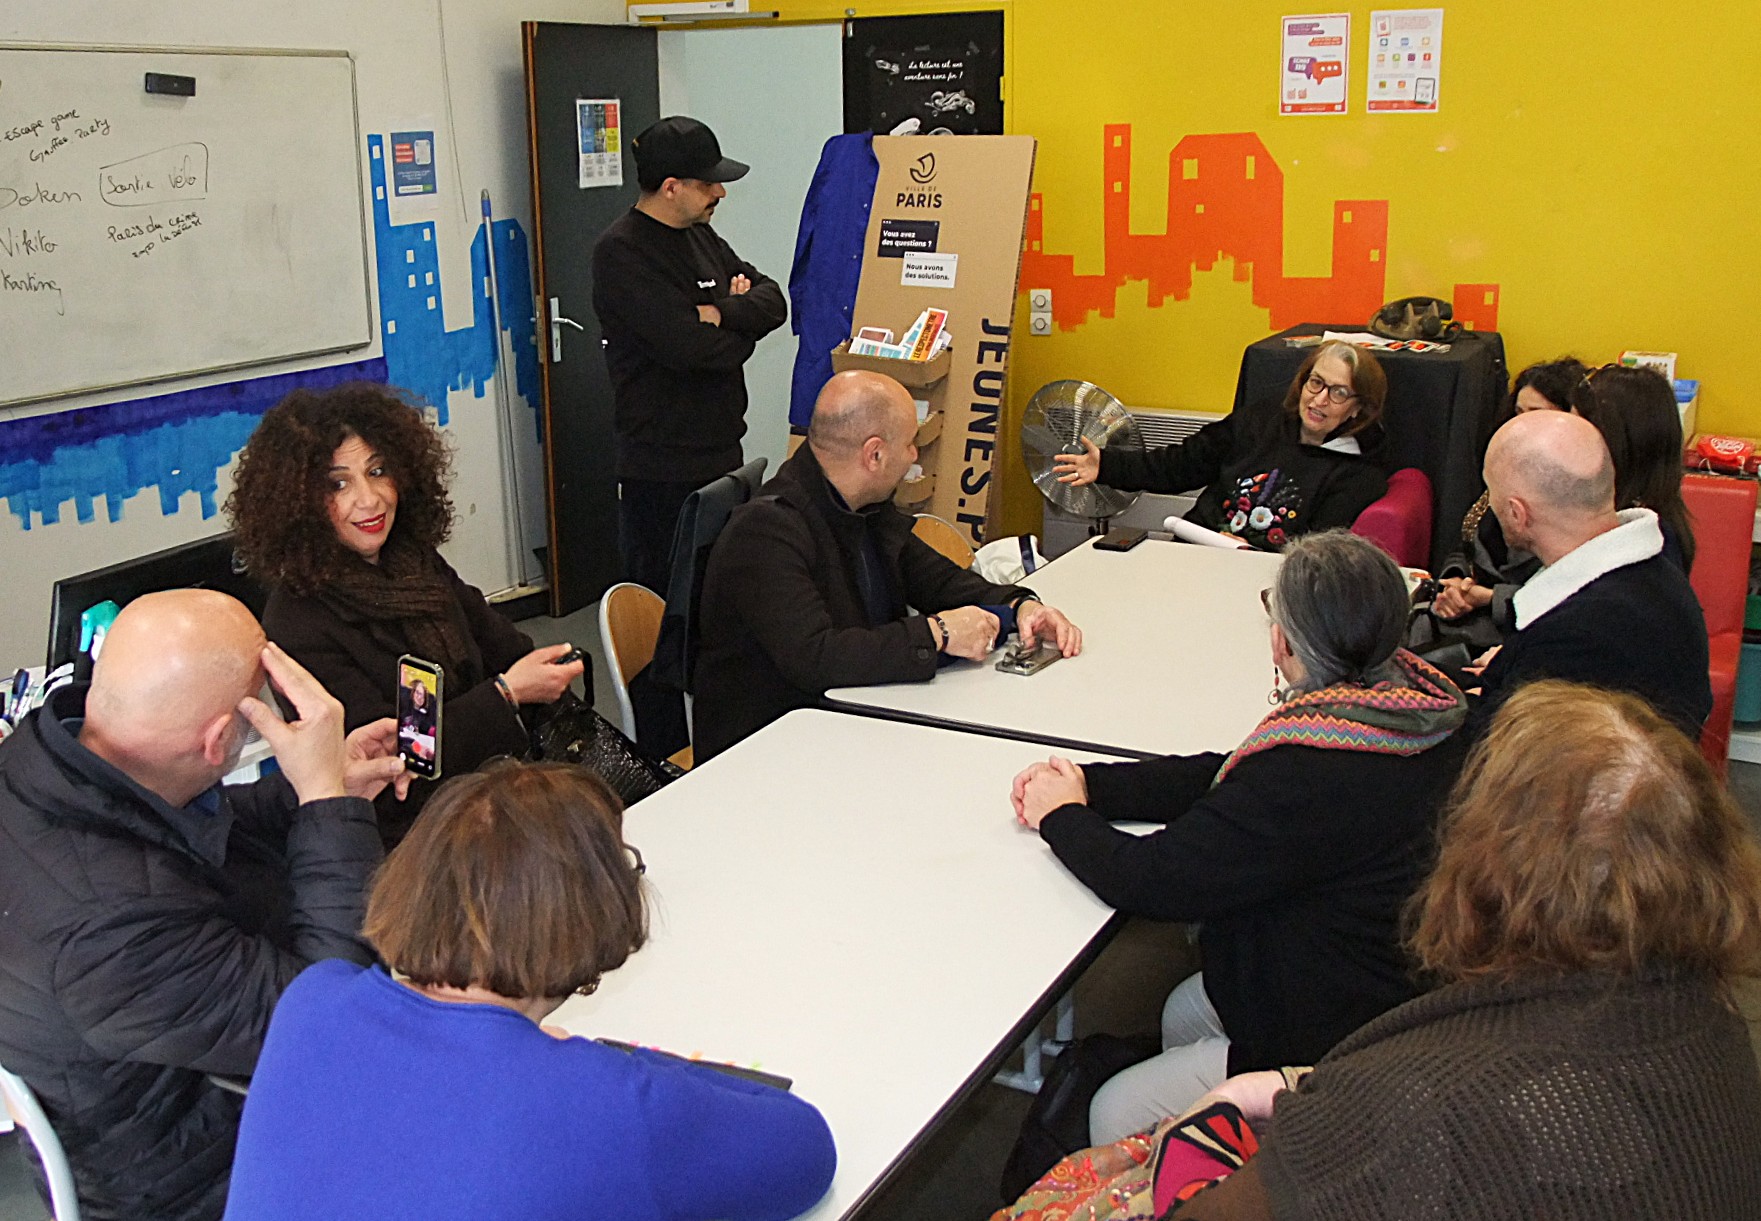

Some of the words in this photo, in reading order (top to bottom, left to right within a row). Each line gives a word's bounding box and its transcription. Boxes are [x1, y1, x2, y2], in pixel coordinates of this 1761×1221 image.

[908, 61, 918, 69] La
[919, 60, 940, 69] lecture
[941, 59, 951, 68] est
[904, 71, 931, 81] aventure
[51, 109, 80, 131] game
[106, 175, 155, 194] Sortie
[896, 192, 943, 209] PARIS
[882, 229, 900, 239] Vous
[900, 231, 916, 239] avez
[881, 238, 894, 246] des
[894, 239, 926, 248] questions
[927, 240, 932, 248] ?
[906, 263, 923, 271] Nous
[924, 264, 944, 272] avons
[918, 272, 950, 281] solutions.
